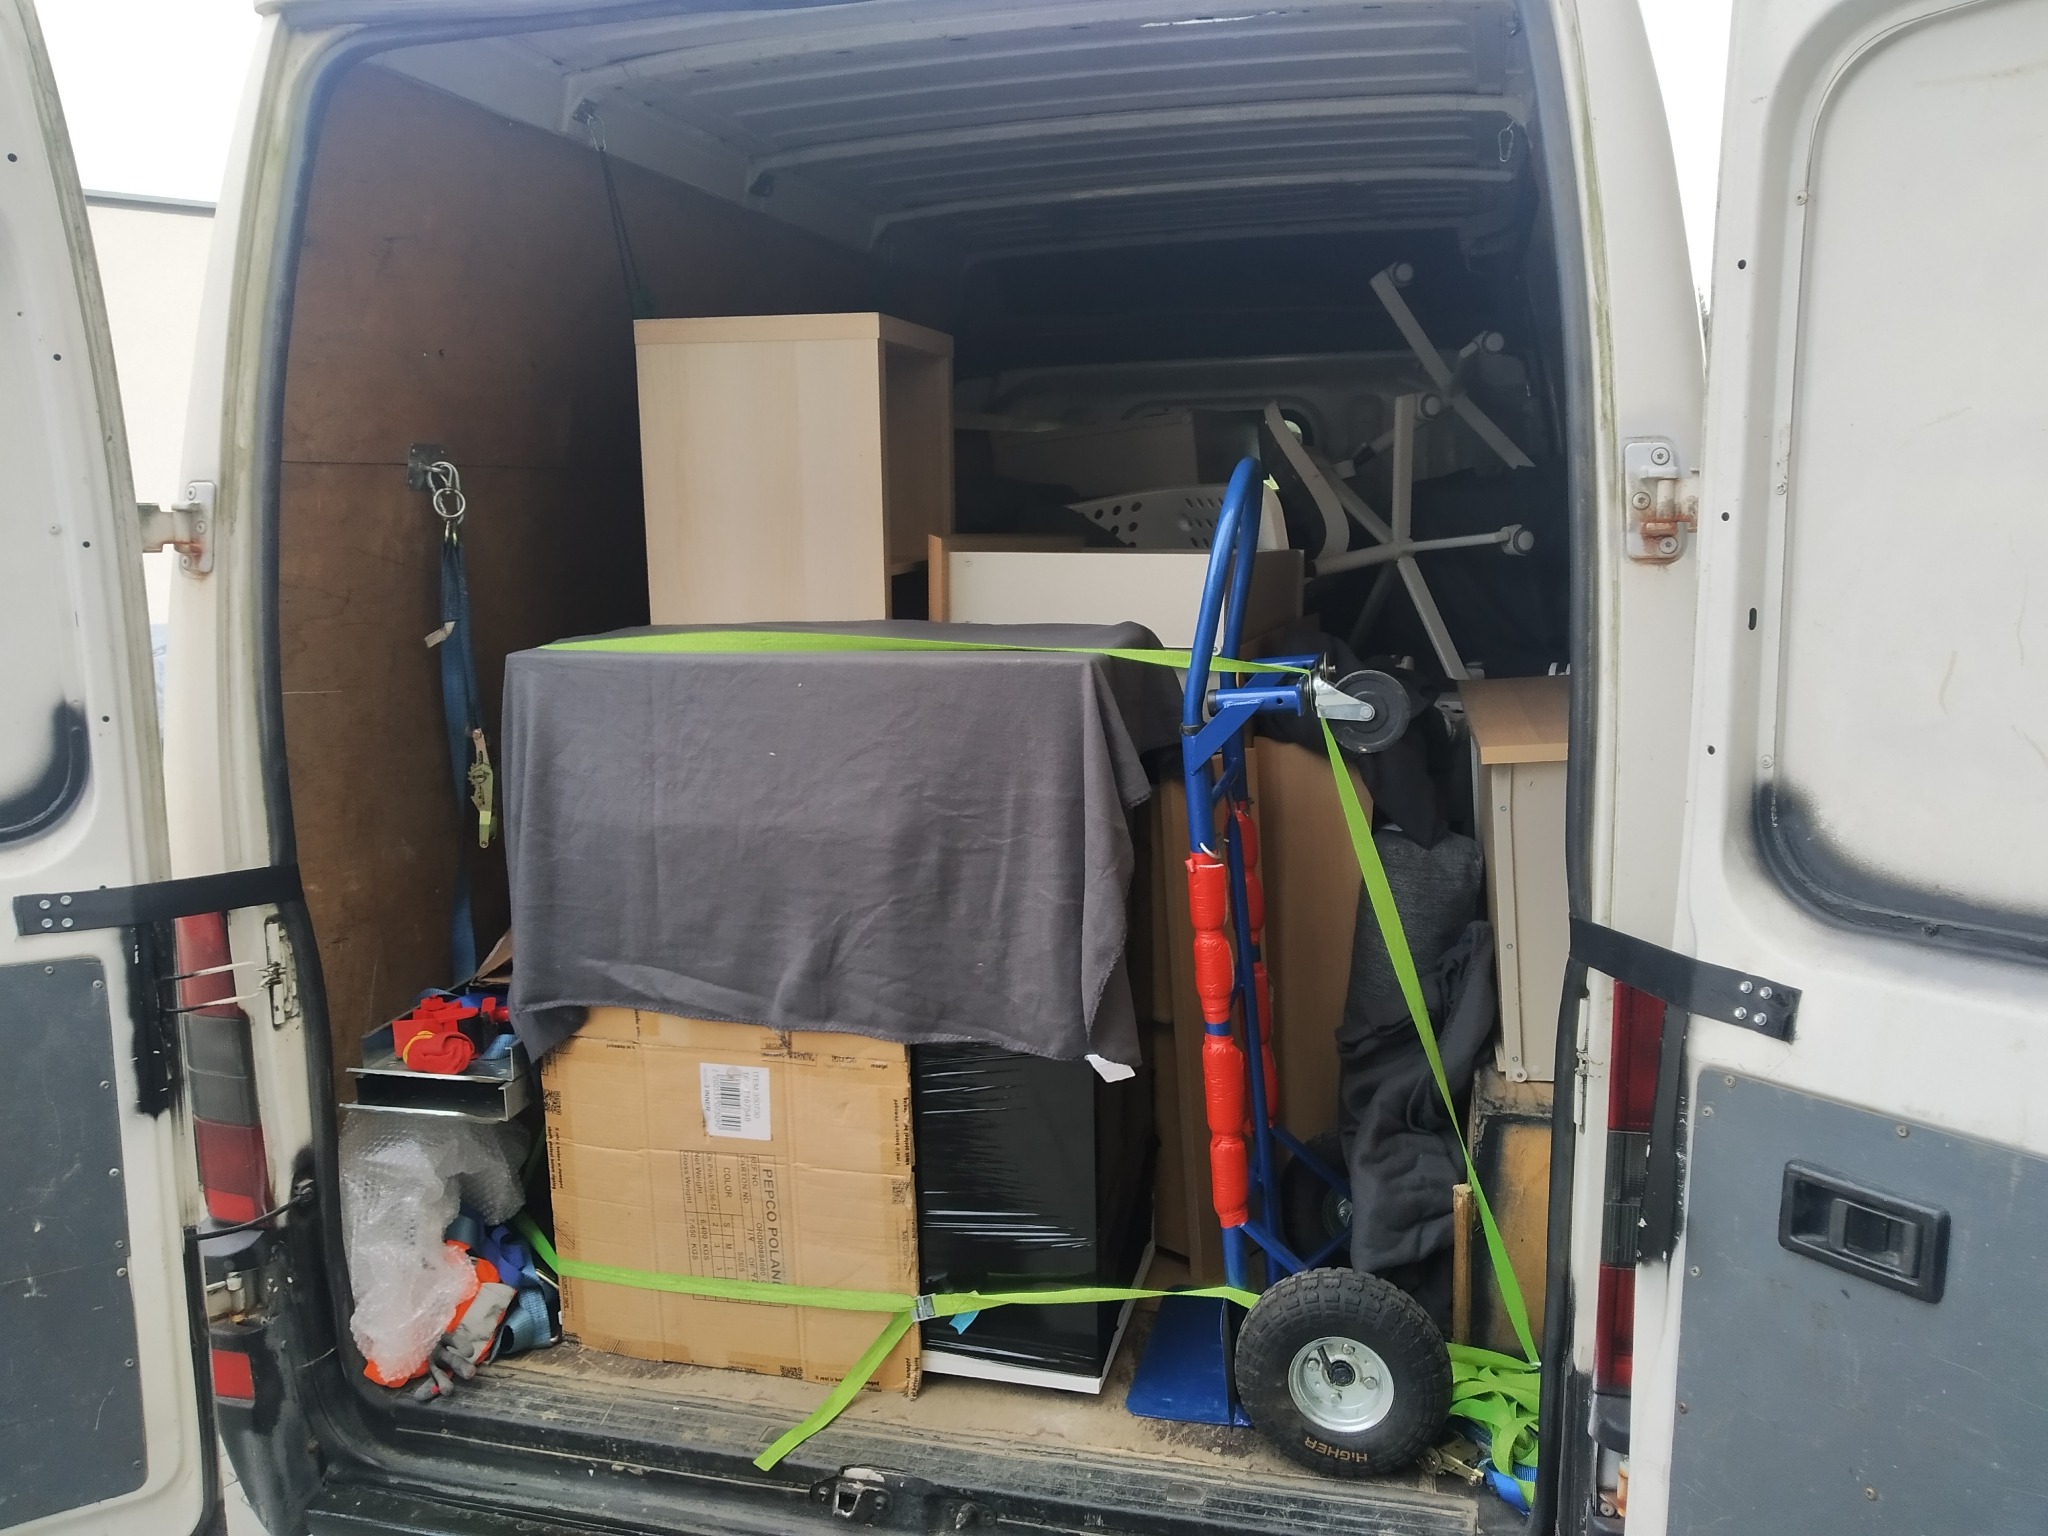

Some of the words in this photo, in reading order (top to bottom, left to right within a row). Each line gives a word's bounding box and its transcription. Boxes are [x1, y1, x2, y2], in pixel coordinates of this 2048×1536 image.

[740, 1155, 748, 1190] CARTON
[750, 1156, 758, 1172] REF
[684, 1176, 692, 1204] Weight
[695, 1167, 703, 1194] Weight
[723, 1167, 733, 1198] COLOR
[752, 1174, 759, 1187] NO
[742, 1191, 750, 1204] NO
[762, 1168, 777, 1222] PEPCO
